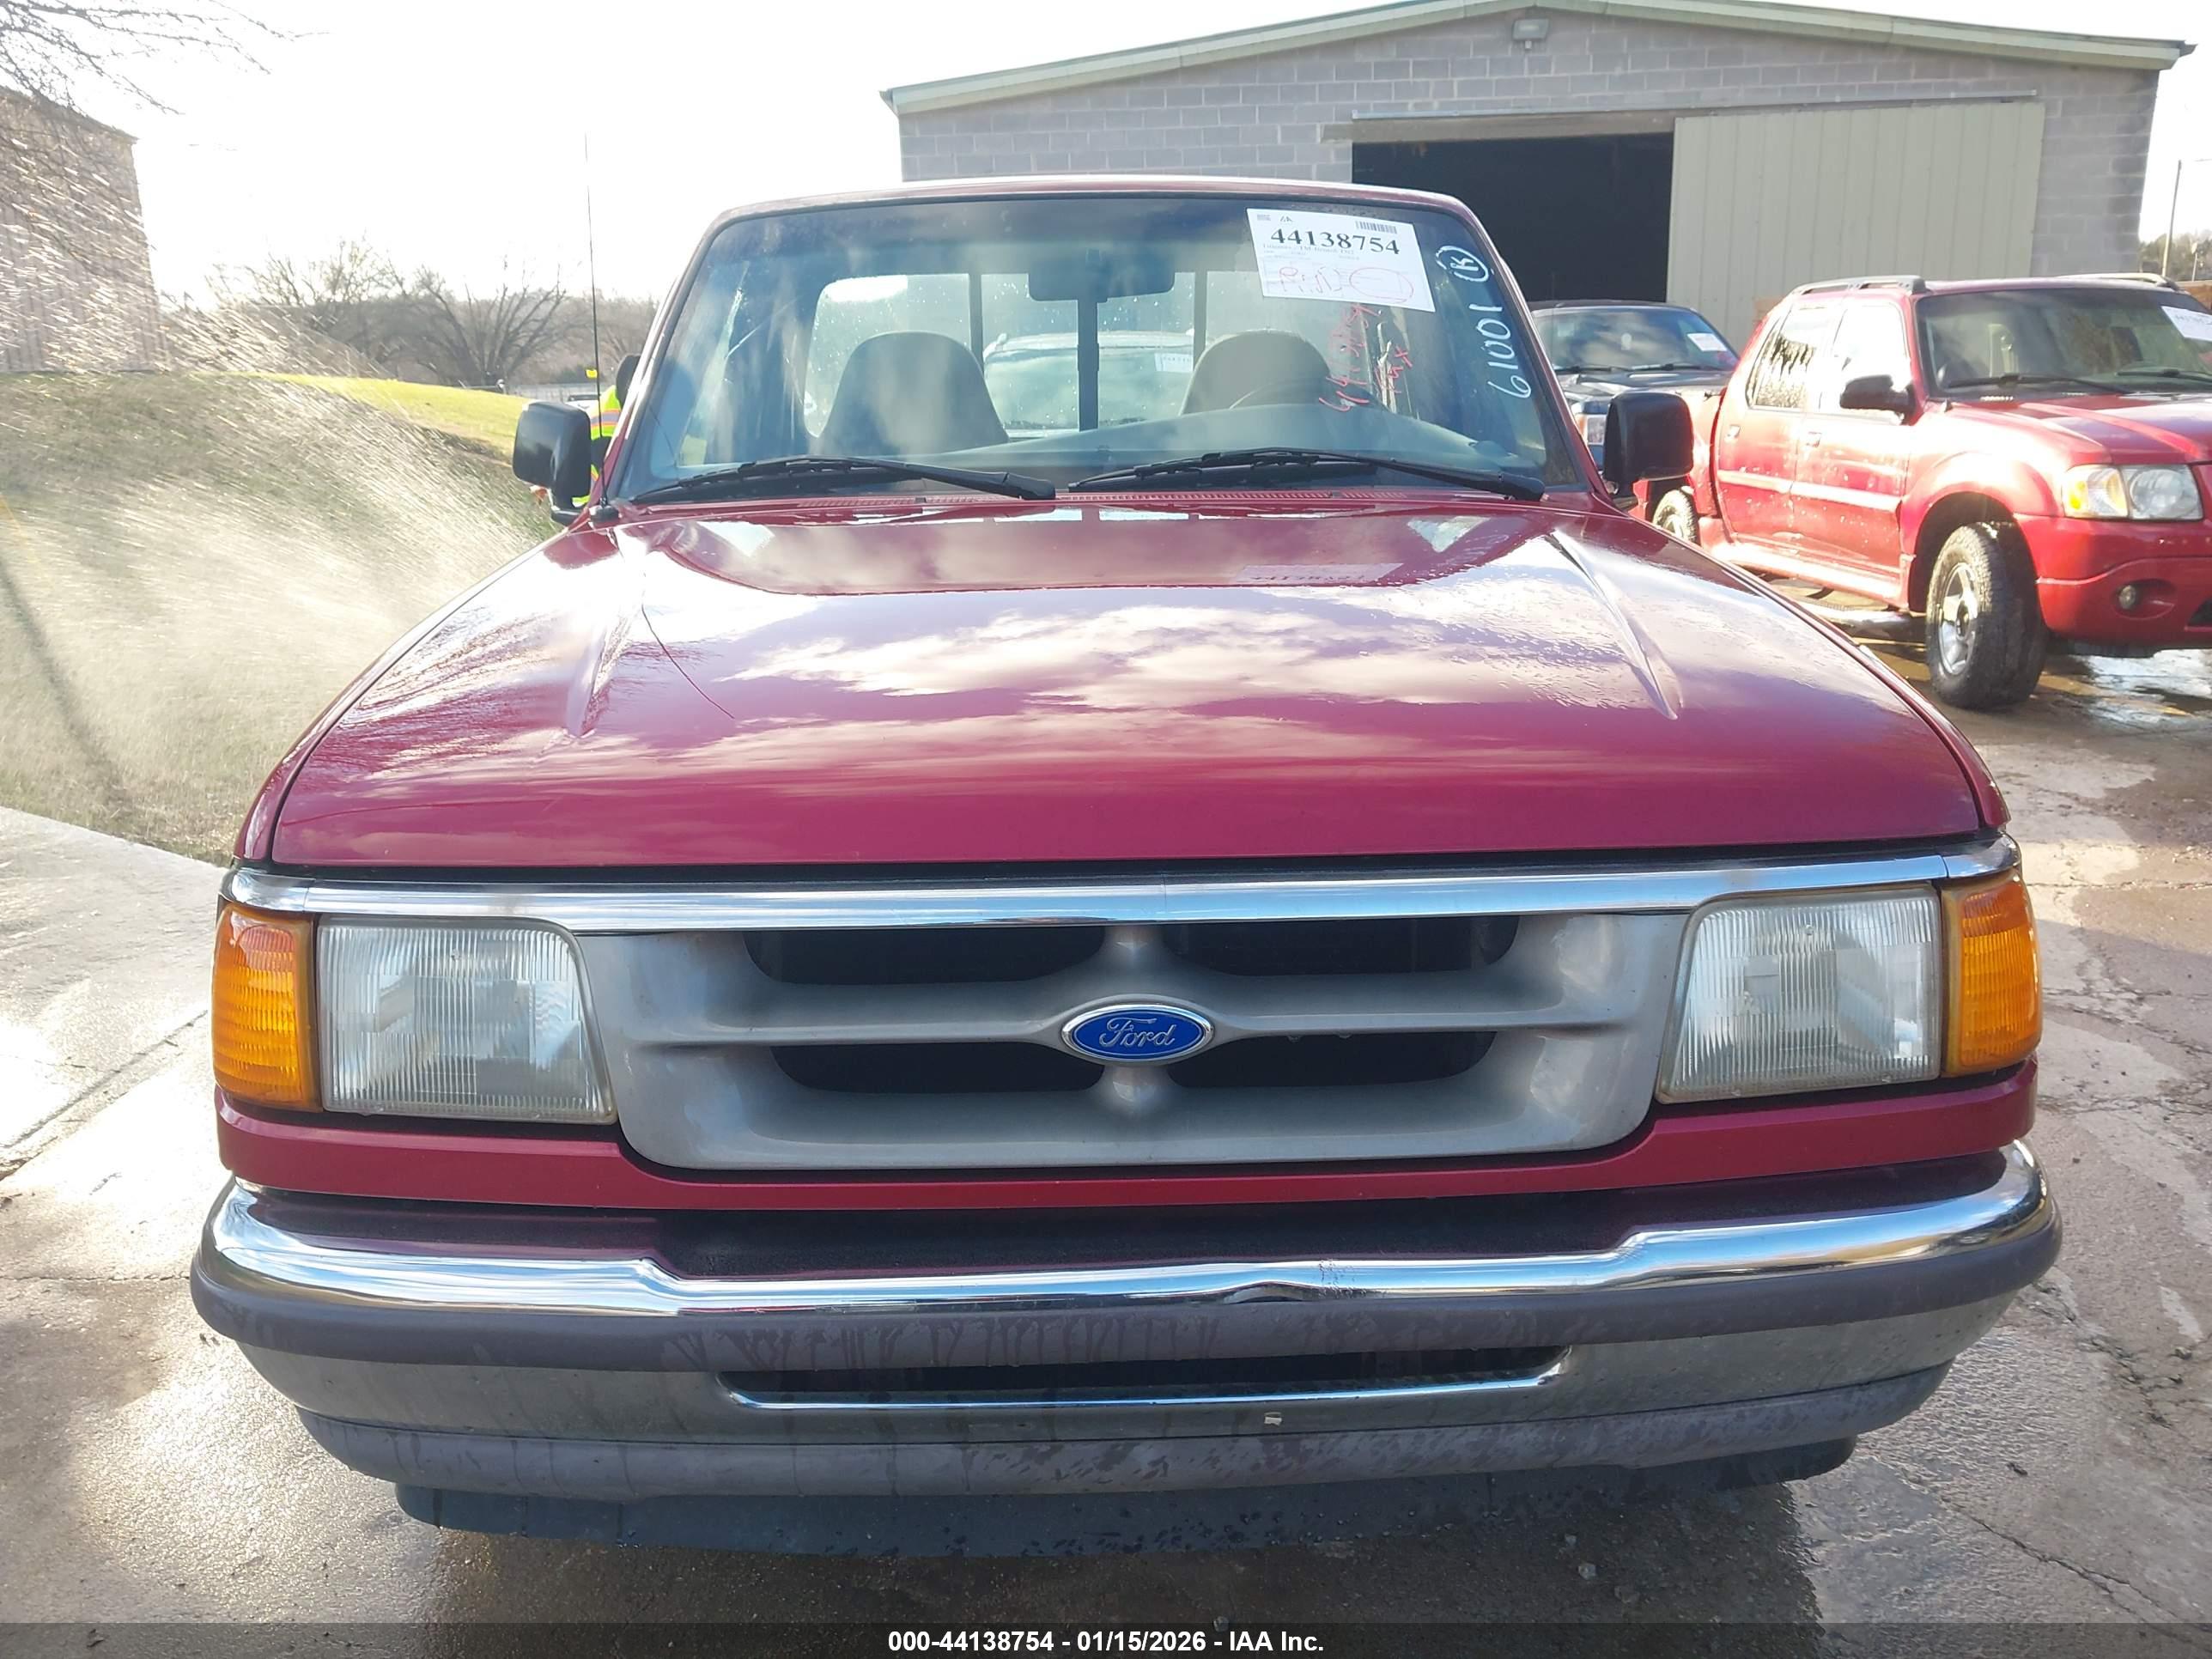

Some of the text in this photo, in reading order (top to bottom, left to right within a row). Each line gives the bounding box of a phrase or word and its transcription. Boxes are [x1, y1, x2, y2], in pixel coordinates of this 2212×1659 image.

[1271, 228, 1400, 254] 44138754
[1468, 303, 1532, 399] 61001
[1099, 1017, 1176, 1047] Ford
